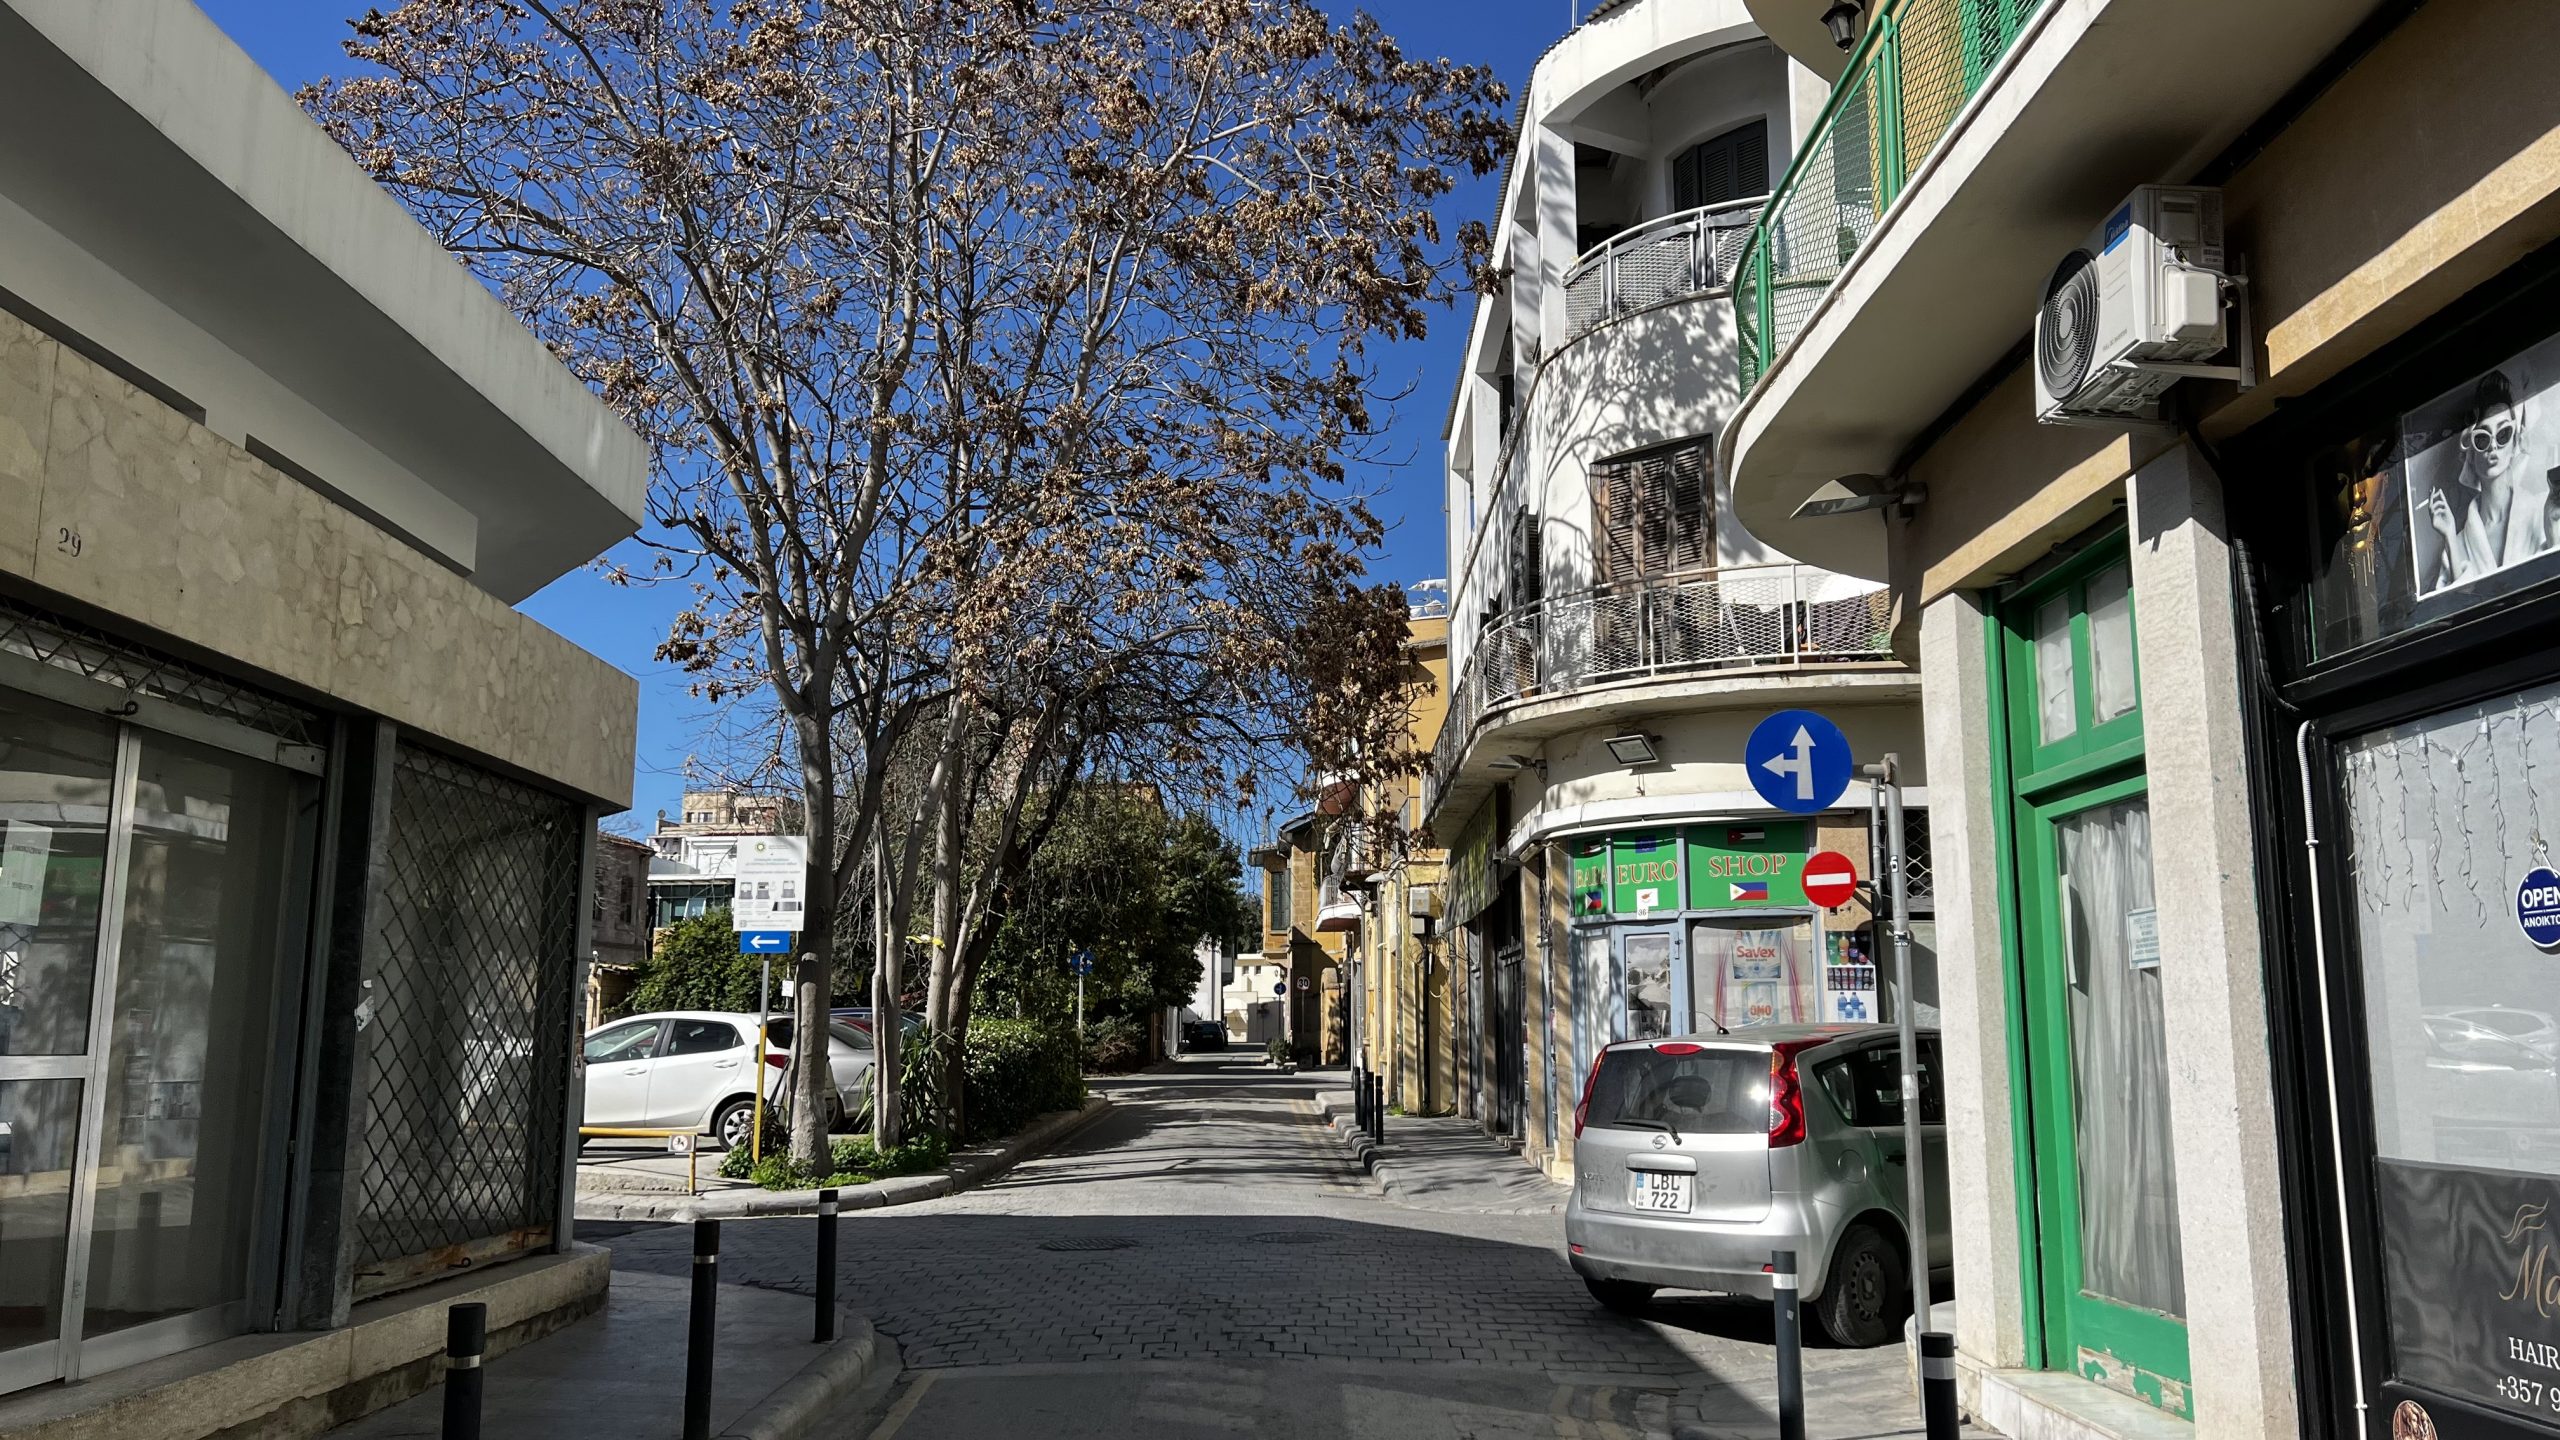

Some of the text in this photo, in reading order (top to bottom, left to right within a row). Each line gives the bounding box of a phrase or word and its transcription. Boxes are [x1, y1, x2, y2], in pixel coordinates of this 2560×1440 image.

[58, 527, 82, 558] 29
[1616, 860, 1679, 885] EURO
[1708, 853, 1787, 878] SHOP
[1736, 945, 1776, 959] Savex
[1651, 1173, 1680, 1191] LBL
[1651, 1191, 1679, 1209] 722
[2496, 1375, 2543, 1406] +357
